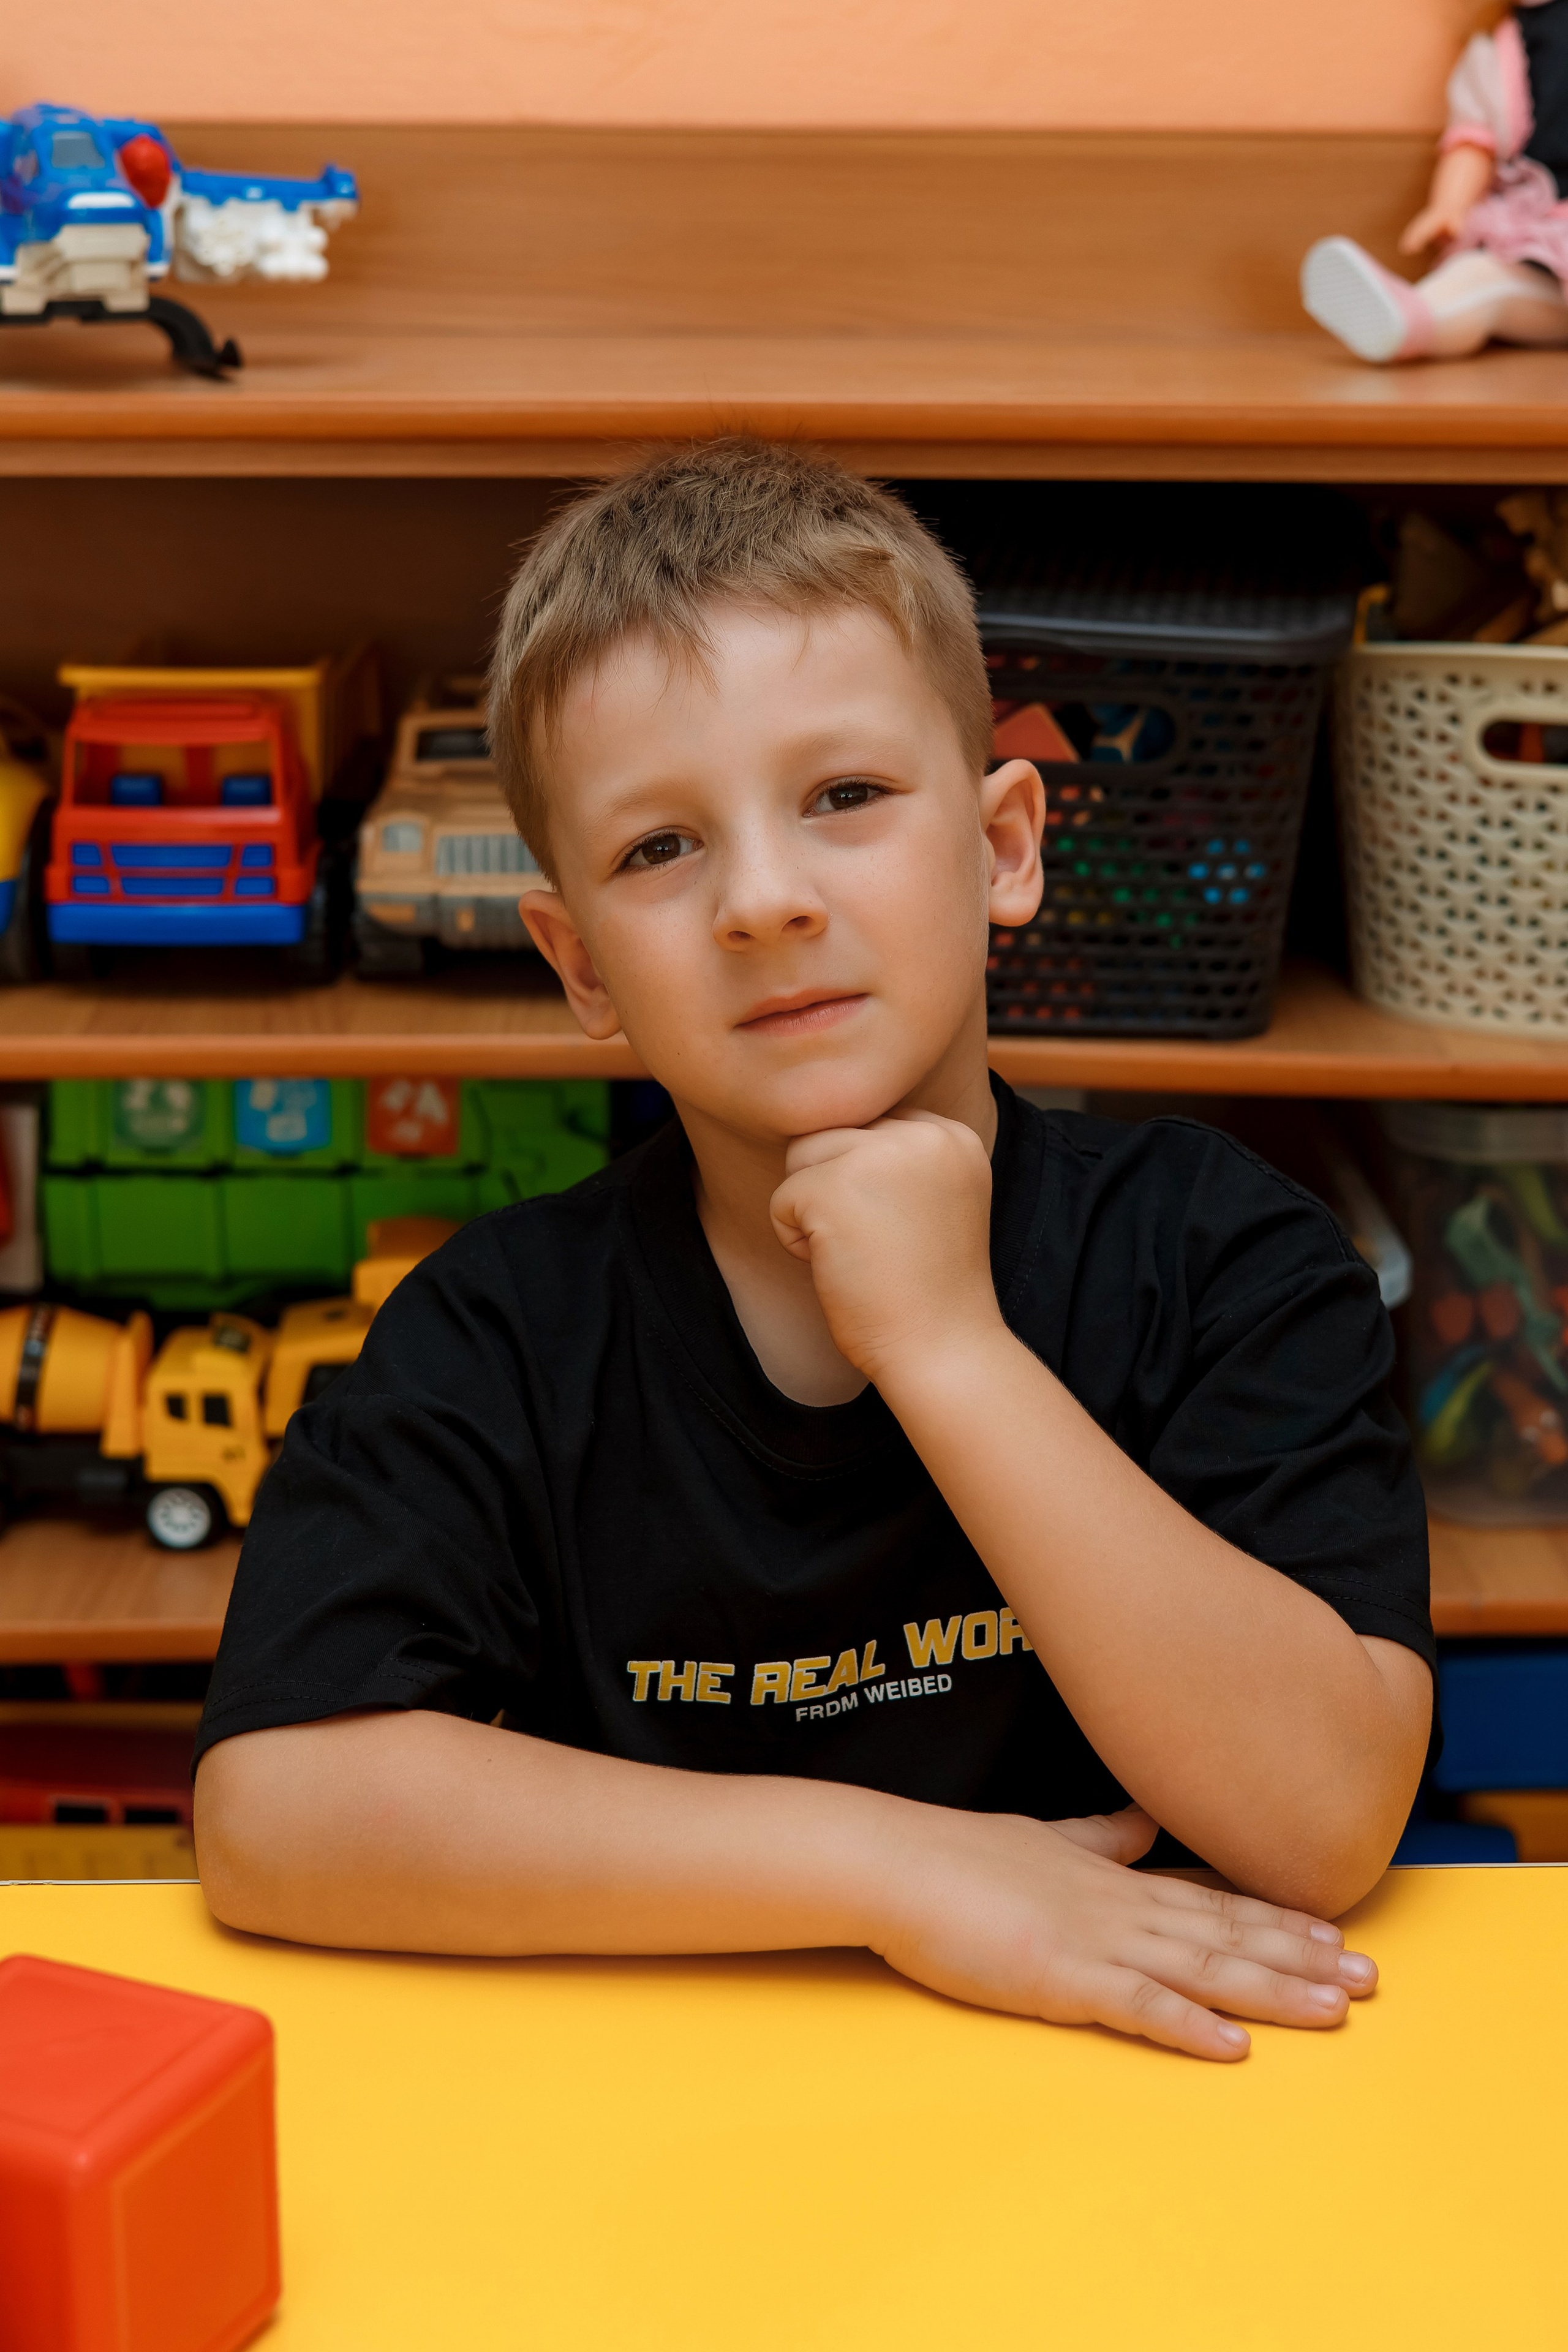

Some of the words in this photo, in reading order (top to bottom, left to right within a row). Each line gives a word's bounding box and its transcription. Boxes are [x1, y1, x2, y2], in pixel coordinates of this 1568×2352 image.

[627, 1660, 735, 1704] THE
[750, 1640, 885, 1705] REAL
[864, 1674, 952, 1703] WEIBED
